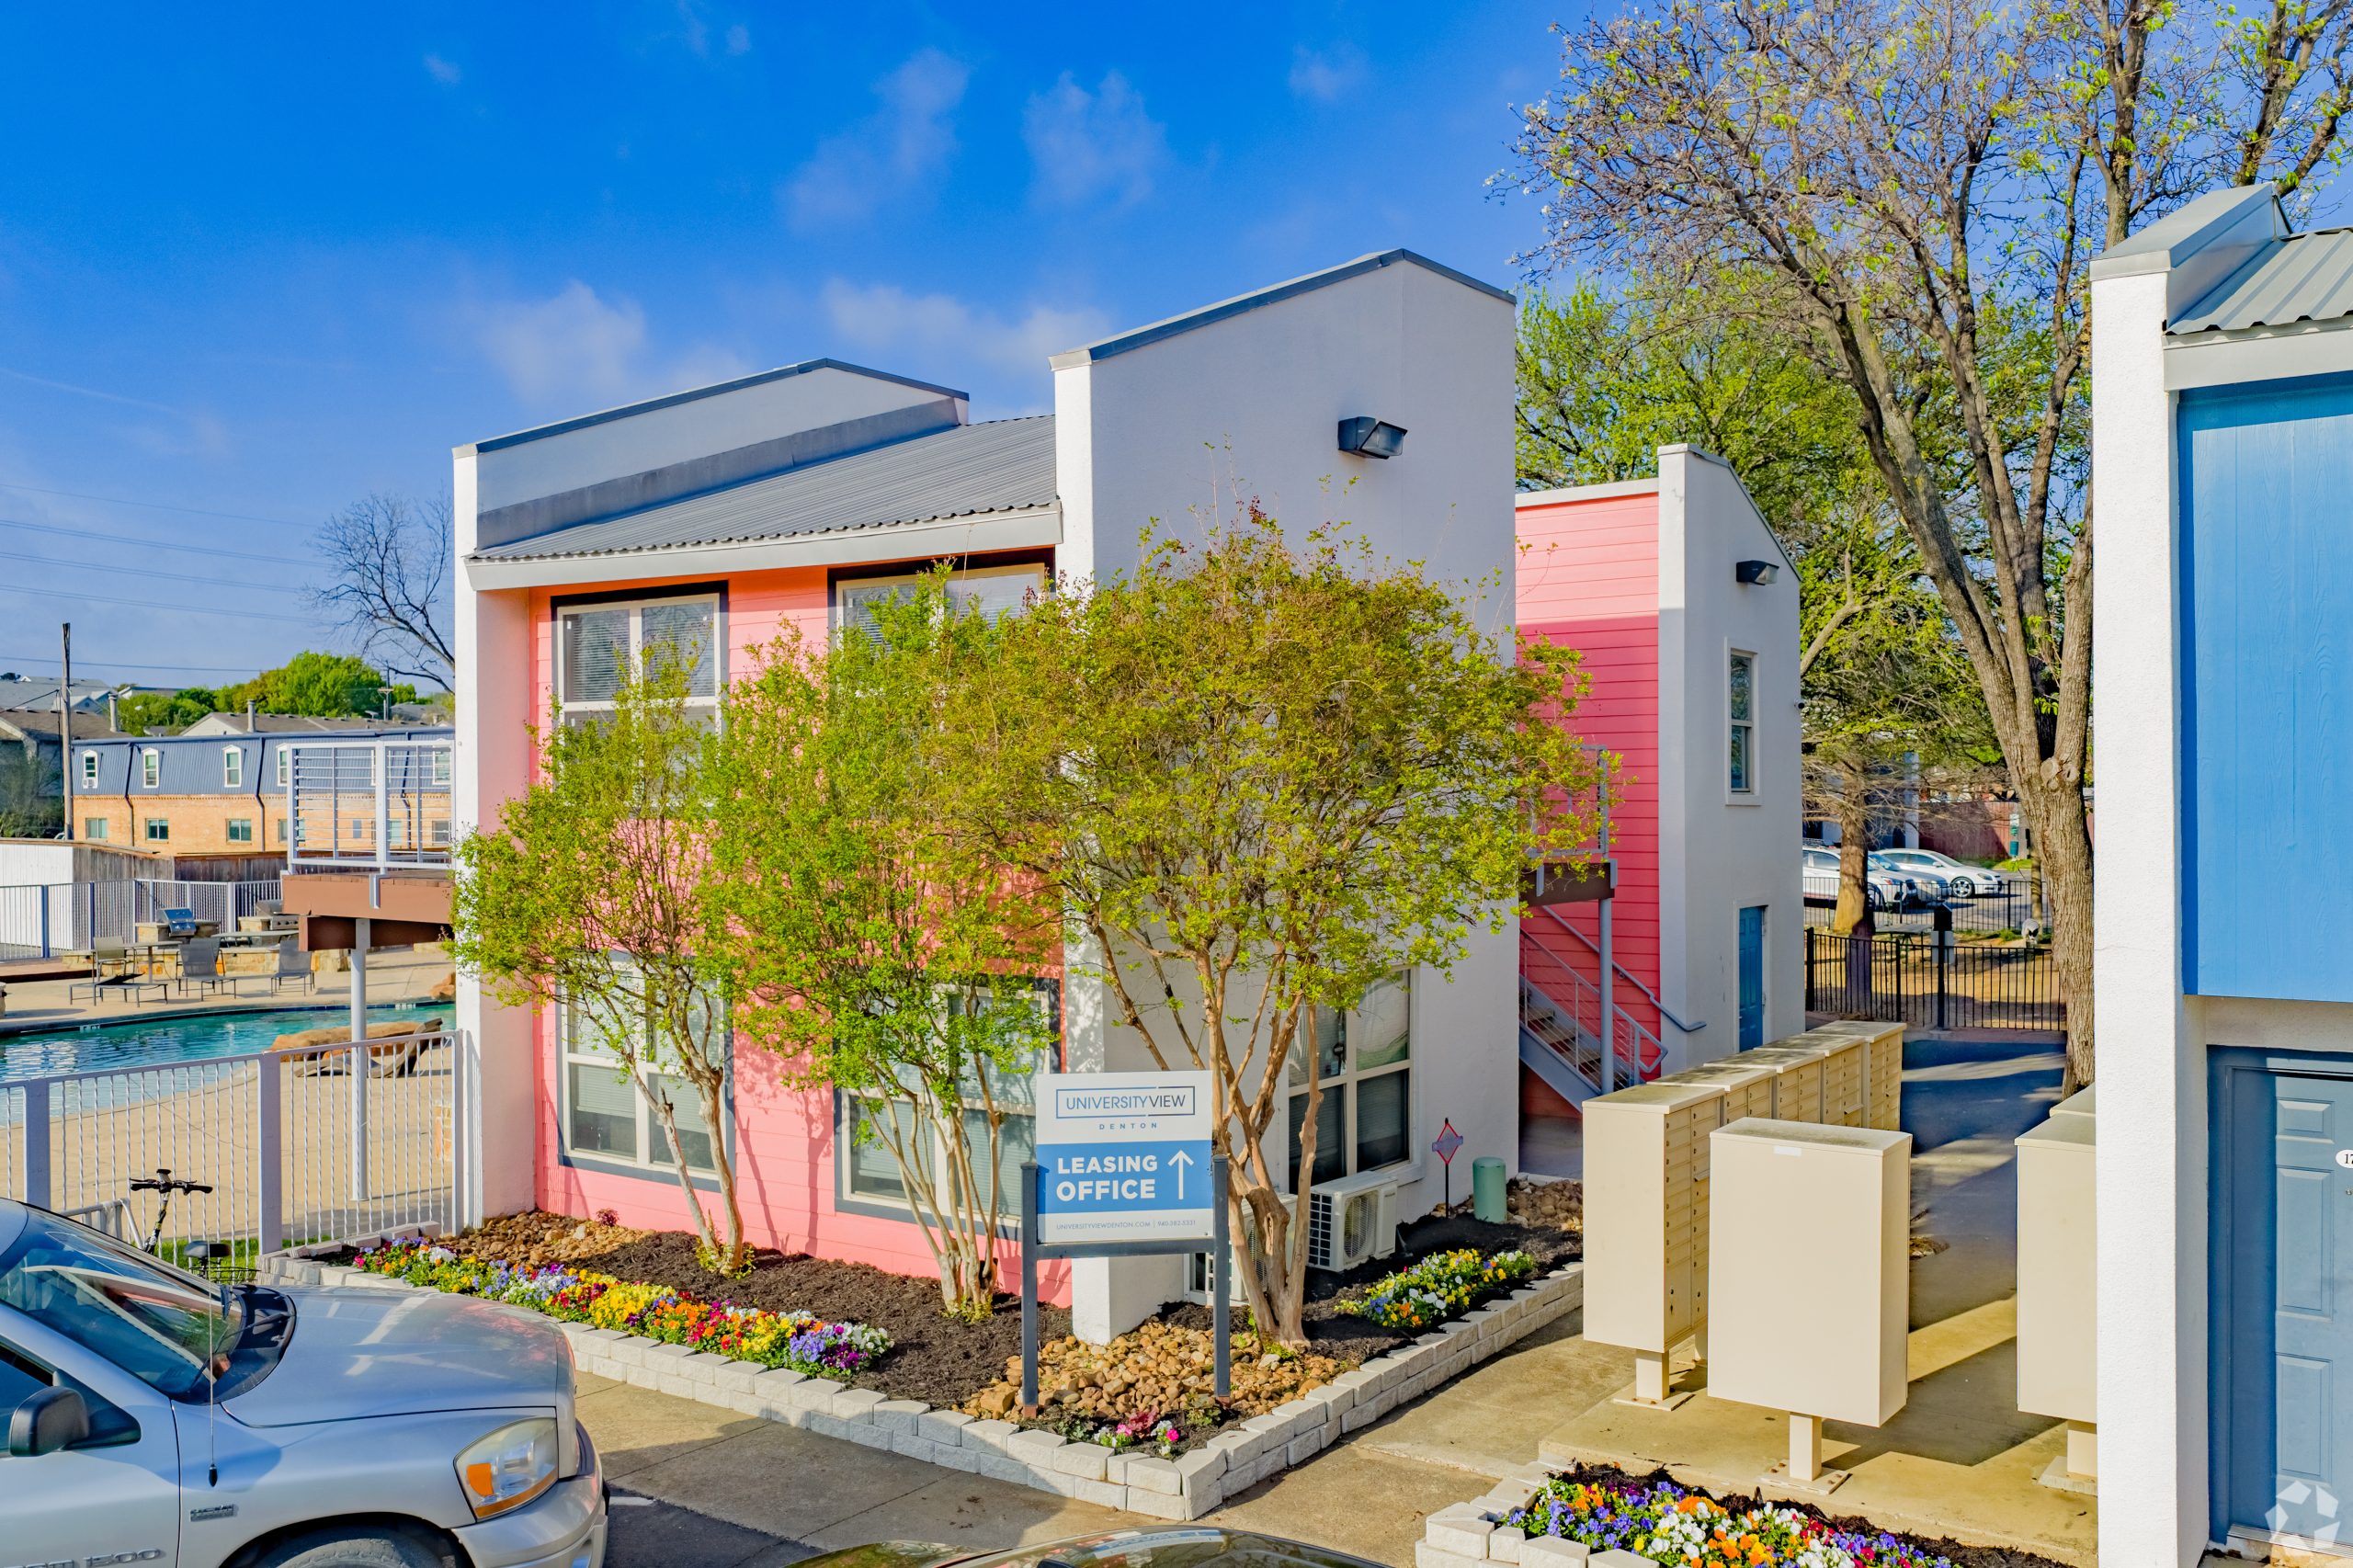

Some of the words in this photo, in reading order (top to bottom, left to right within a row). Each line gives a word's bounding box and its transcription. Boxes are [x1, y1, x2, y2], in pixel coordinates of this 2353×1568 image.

[1098, 1122, 1158, 1131] DENTON
[1057, 1154, 1158, 1175] LEASING
[1056, 1178, 1156, 1202] OFFICE
